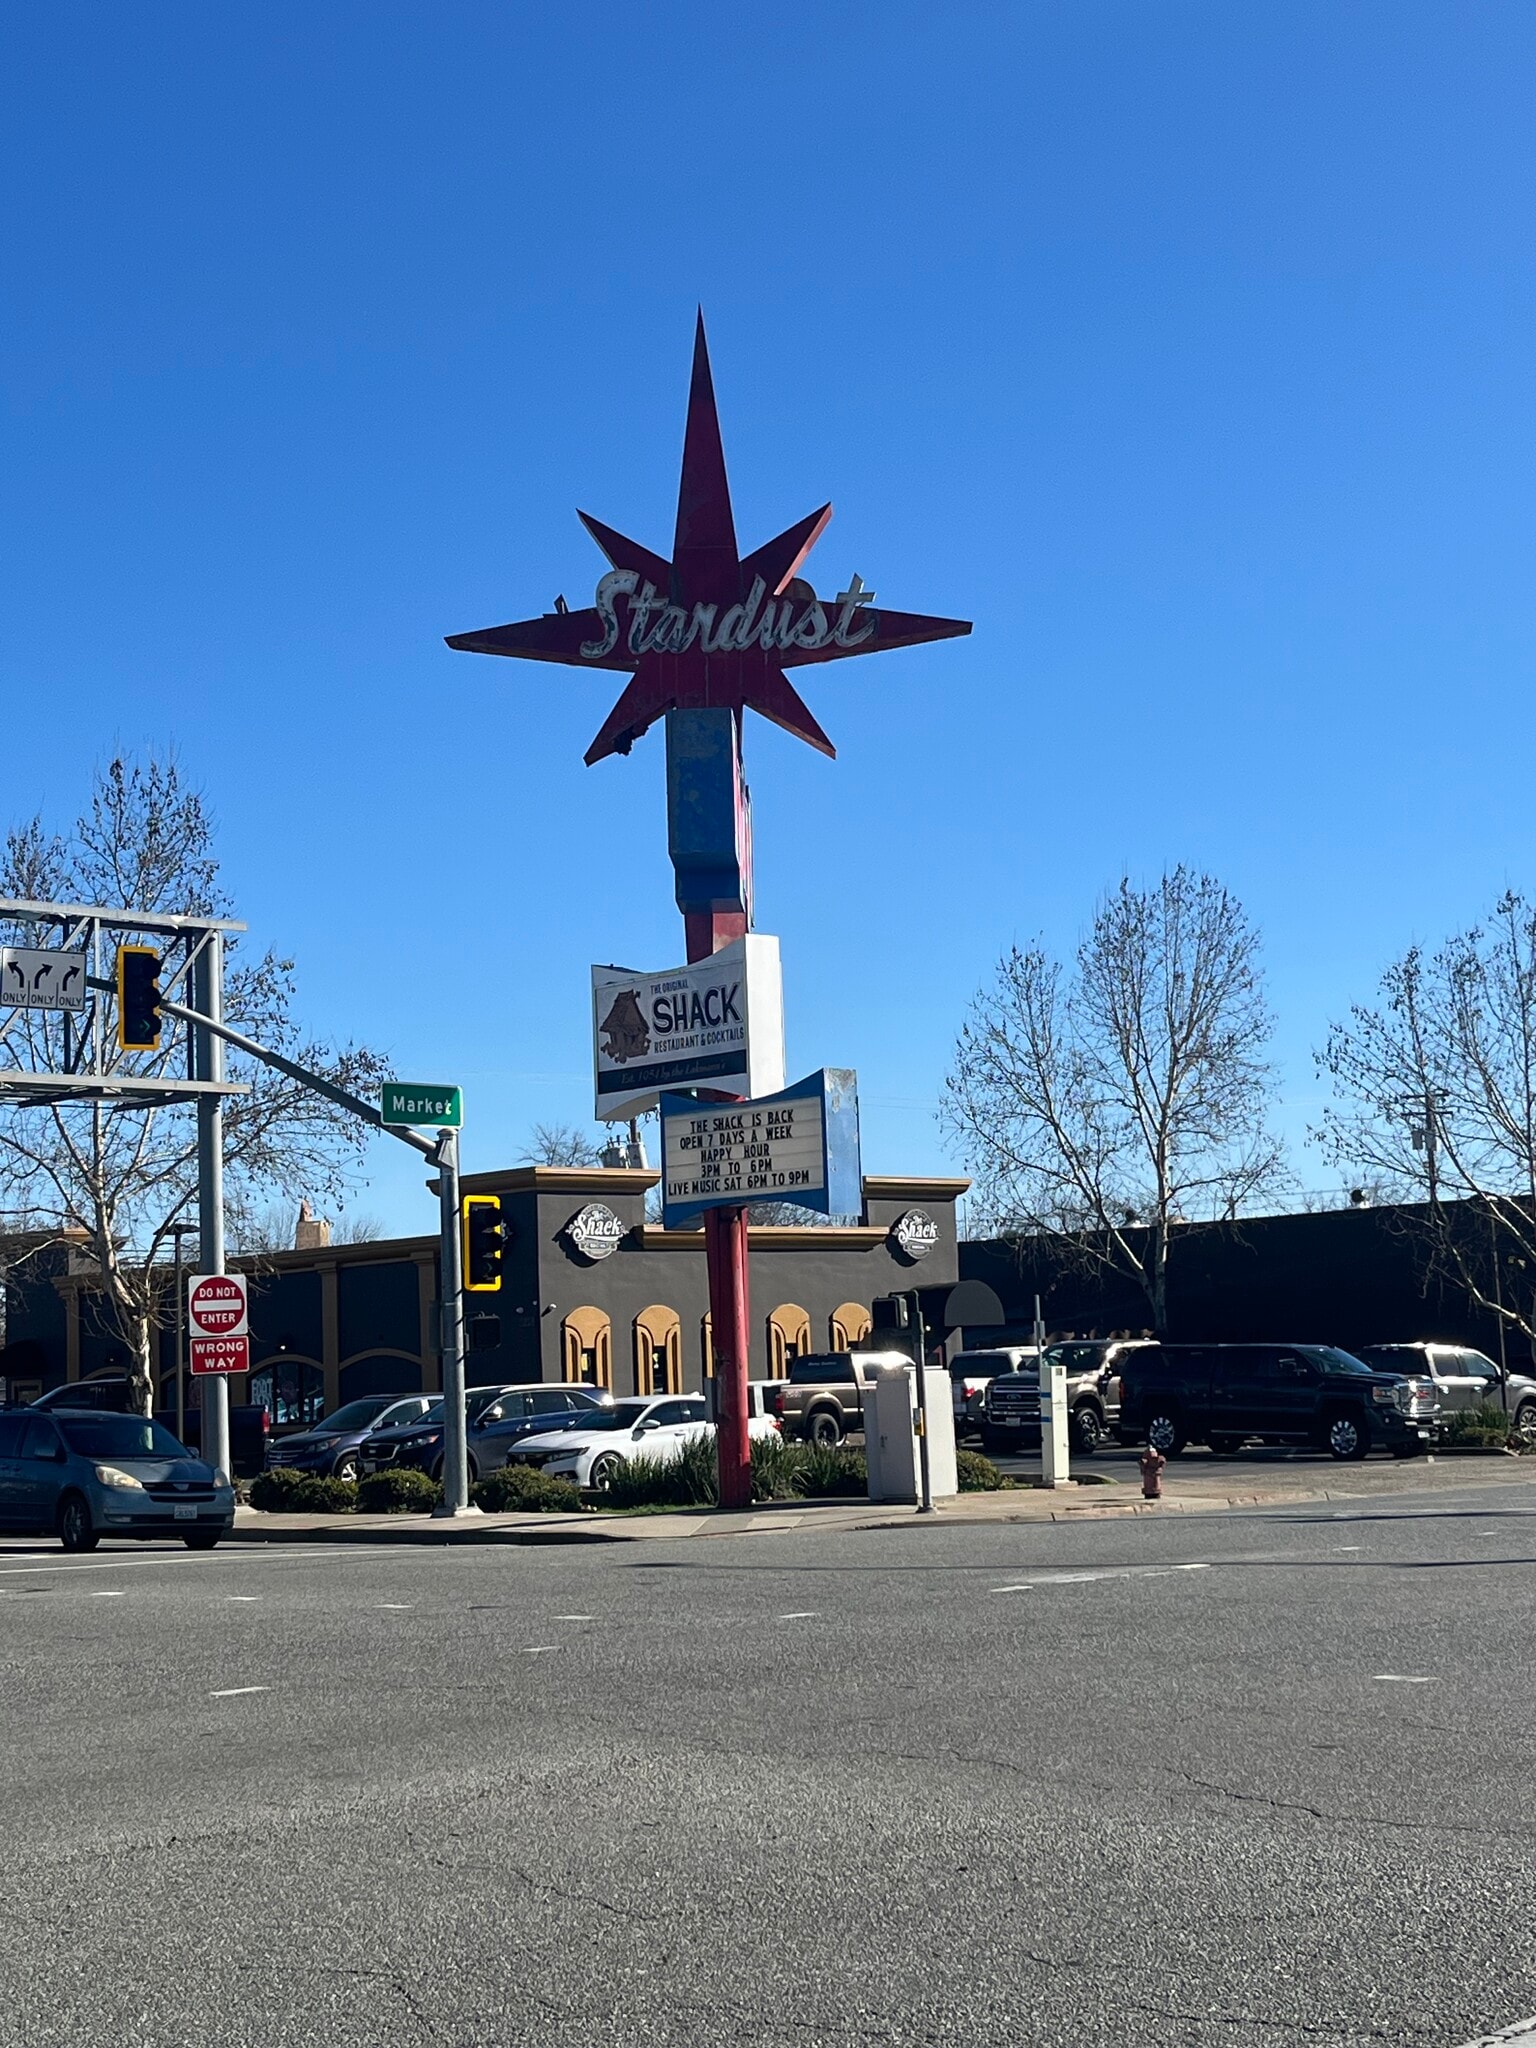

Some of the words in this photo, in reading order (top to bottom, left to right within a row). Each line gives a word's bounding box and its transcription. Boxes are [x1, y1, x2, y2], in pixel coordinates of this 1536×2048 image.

[580, 569, 879, 658] Stardust
[650, 984, 662, 995] THE
[662, 979, 688, 993] ORIGINAL
[3, 992, 26, 1003] ONLY
[31, 994, 54, 1005] ONLY
[59, 997, 82, 1007] ONLY
[653, 983, 741, 1034] SHACK
[654, 1034, 699, 1053] RESTAURANT
[700, 1034, 706, 1046] &
[706, 1026, 744, 1045] COCKTAILS
[393, 1095, 452, 1115] Market
[690, 1119, 708, 1134] THE
[713, 1115, 744, 1130] SHACK
[752, 1113, 762, 1126] IS
[768, 1109, 794, 1125] BACK
[679, 1135, 703, 1150] OPEN
[707, 1134, 714, 1147] 7
[719, 1131, 745, 1146] DAYS
[751, 1129, 758, 1142] A
[766, 1125, 792, 1141] WEEK
[701, 1147, 732, 1162] HAPPY
[743, 1143, 770, 1159] HOUR
[701, 1163, 720, 1178] 3PM
[728, 1161, 741, 1175] TO
[750, 1158, 772, 1173] 6PM
[668, 1181, 689, 1196] LIVE
[692, 1178, 721, 1194] MUSIC
[724, 1176, 742, 1191] SAT
[747, 1174, 767, 1188] 6PM
[771, 1173, 785, 1186] TO
[788, 1169, 809, 1185] 9PM
[573, 1214, 622, 1241] Shack
[898, 1218, 938, 1243] Shack
[199, 1287, 213, 1298] DO
[216, 1287, 236, 1298] NOT
[201, 1313, 236, 1324] ENTER
[195, 1341, 245, 1354] WRONG
[204, 1357, 236, 1369] WAY
